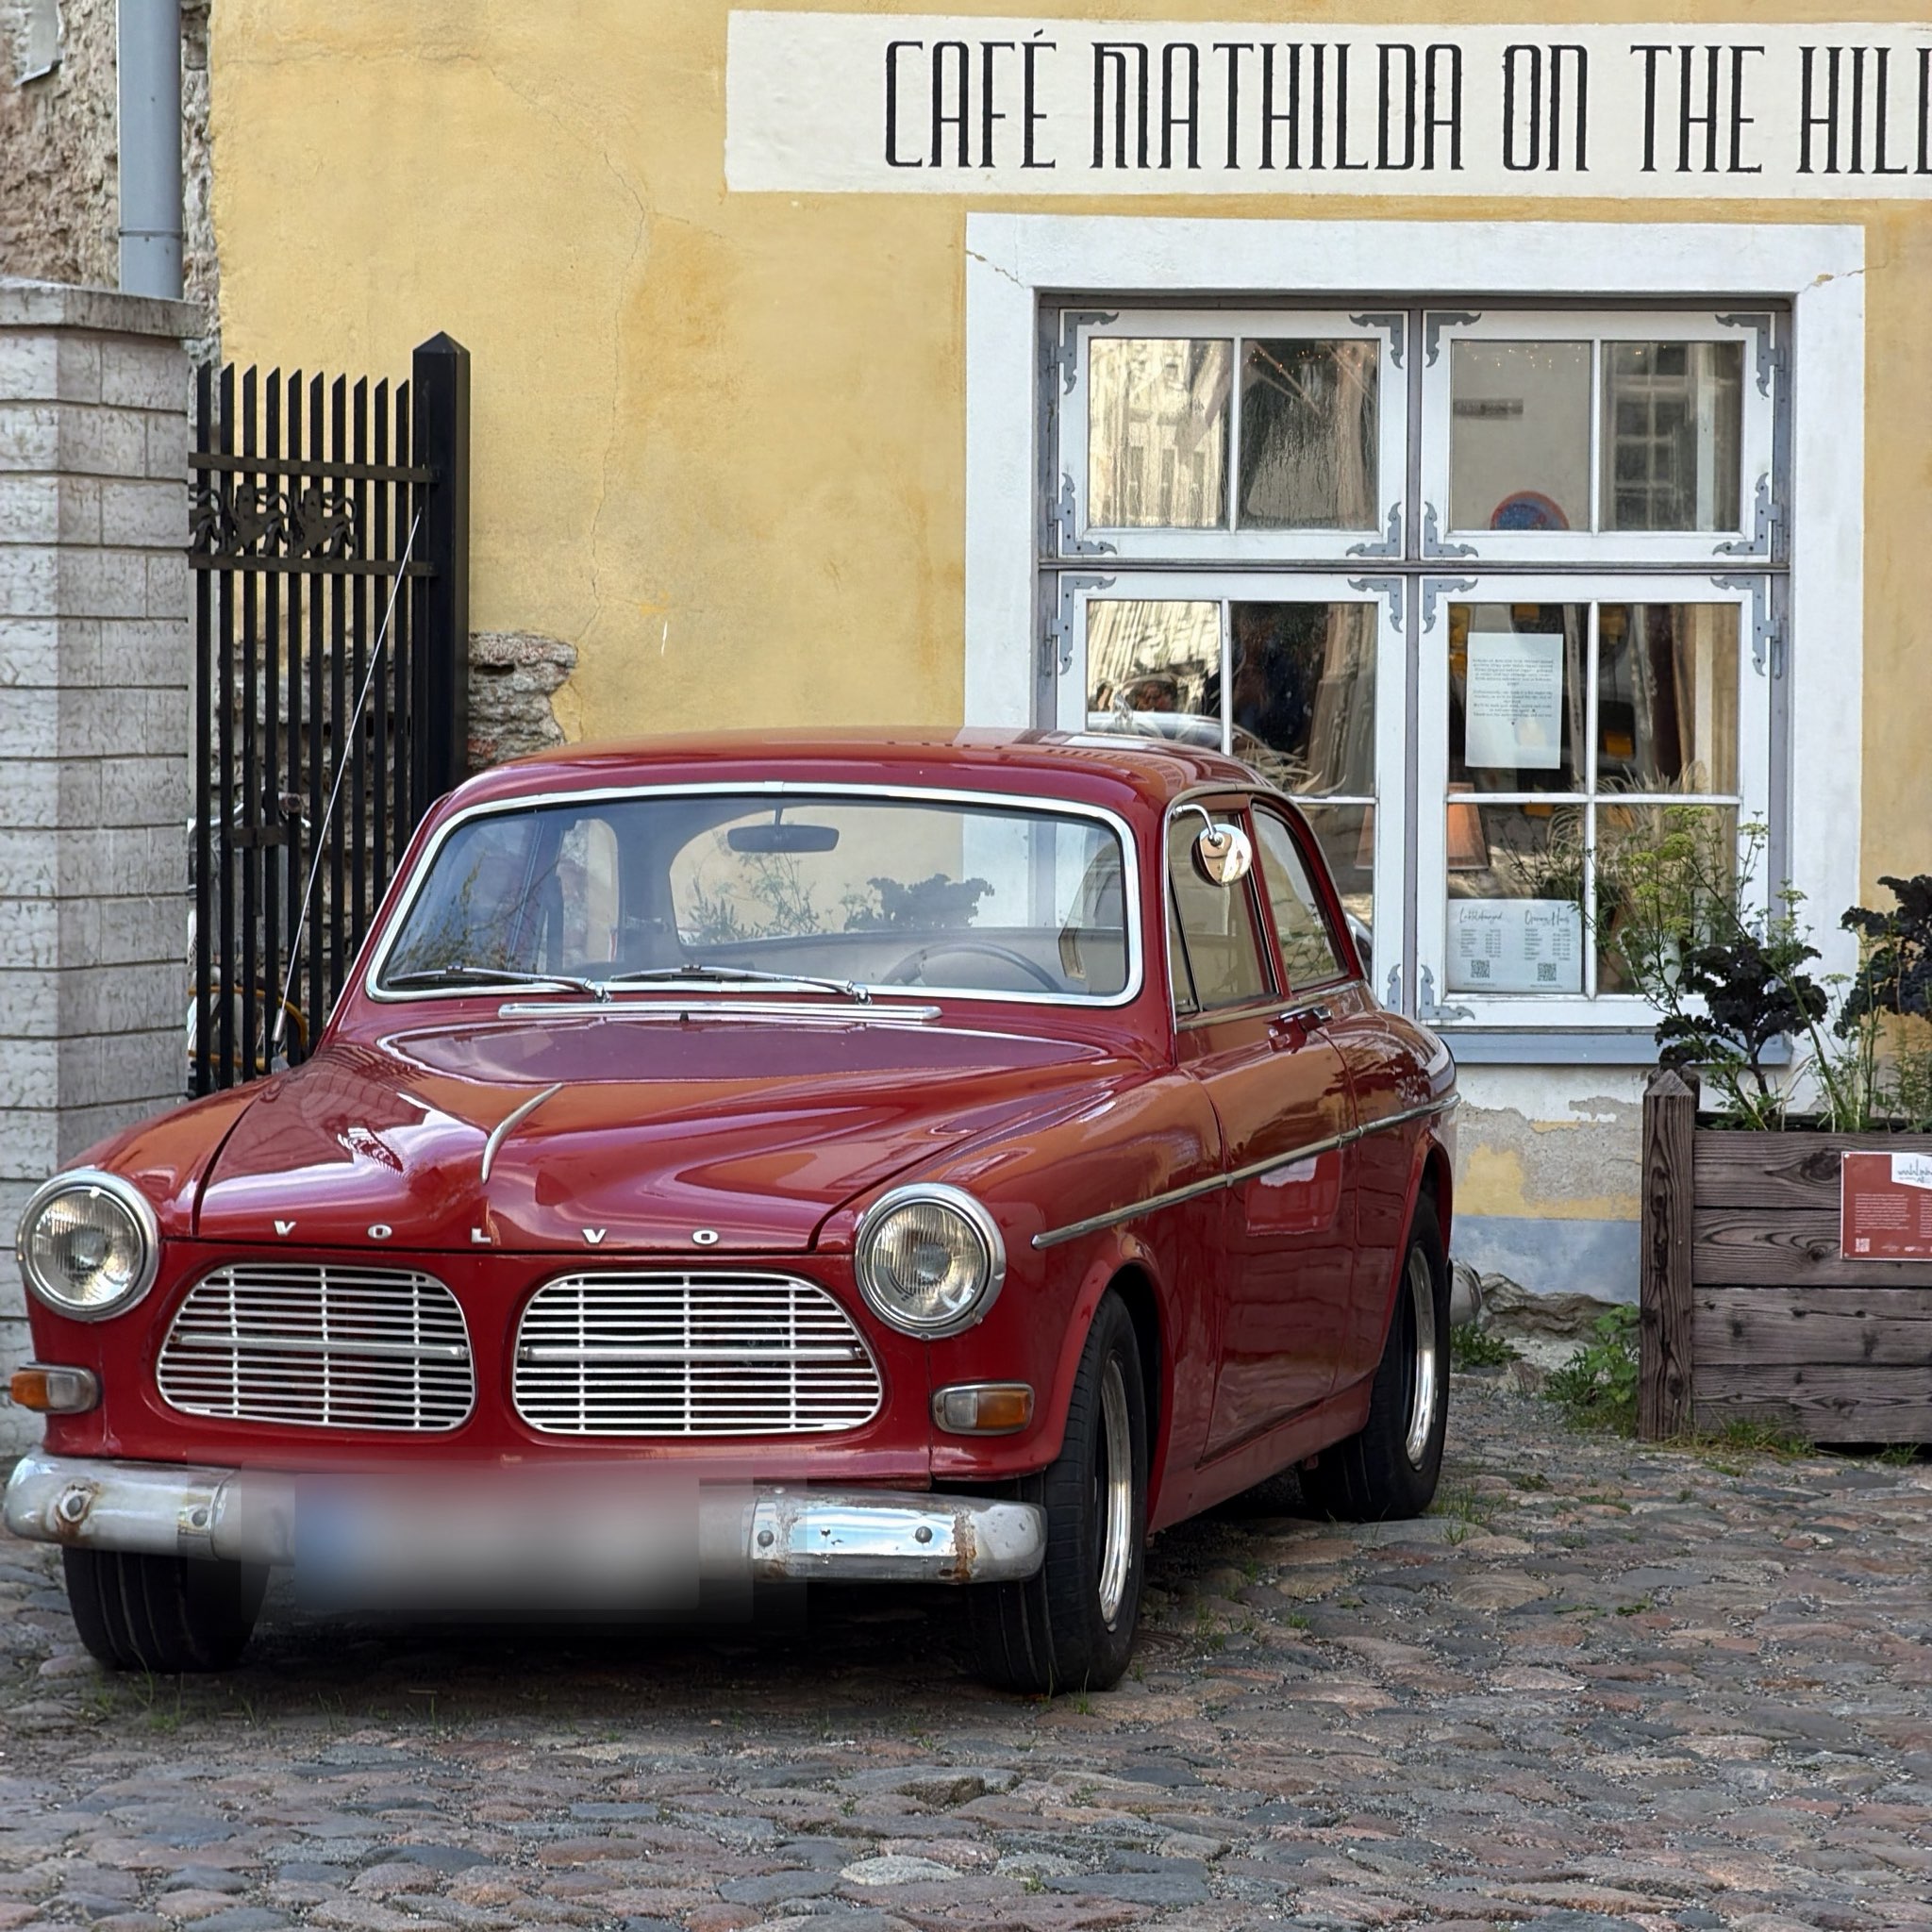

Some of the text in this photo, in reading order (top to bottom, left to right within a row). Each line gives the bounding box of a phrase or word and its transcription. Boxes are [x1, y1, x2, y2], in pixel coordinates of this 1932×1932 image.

[886, 29, 1056, 168] CAFÉ
[1091, 42, 1463, 170] MATHILDA
[1503, 45, 1589, 171] ON
[1631, 45, 1764, 173] THE
[274, 1220, 719, 1245] VOLVO
